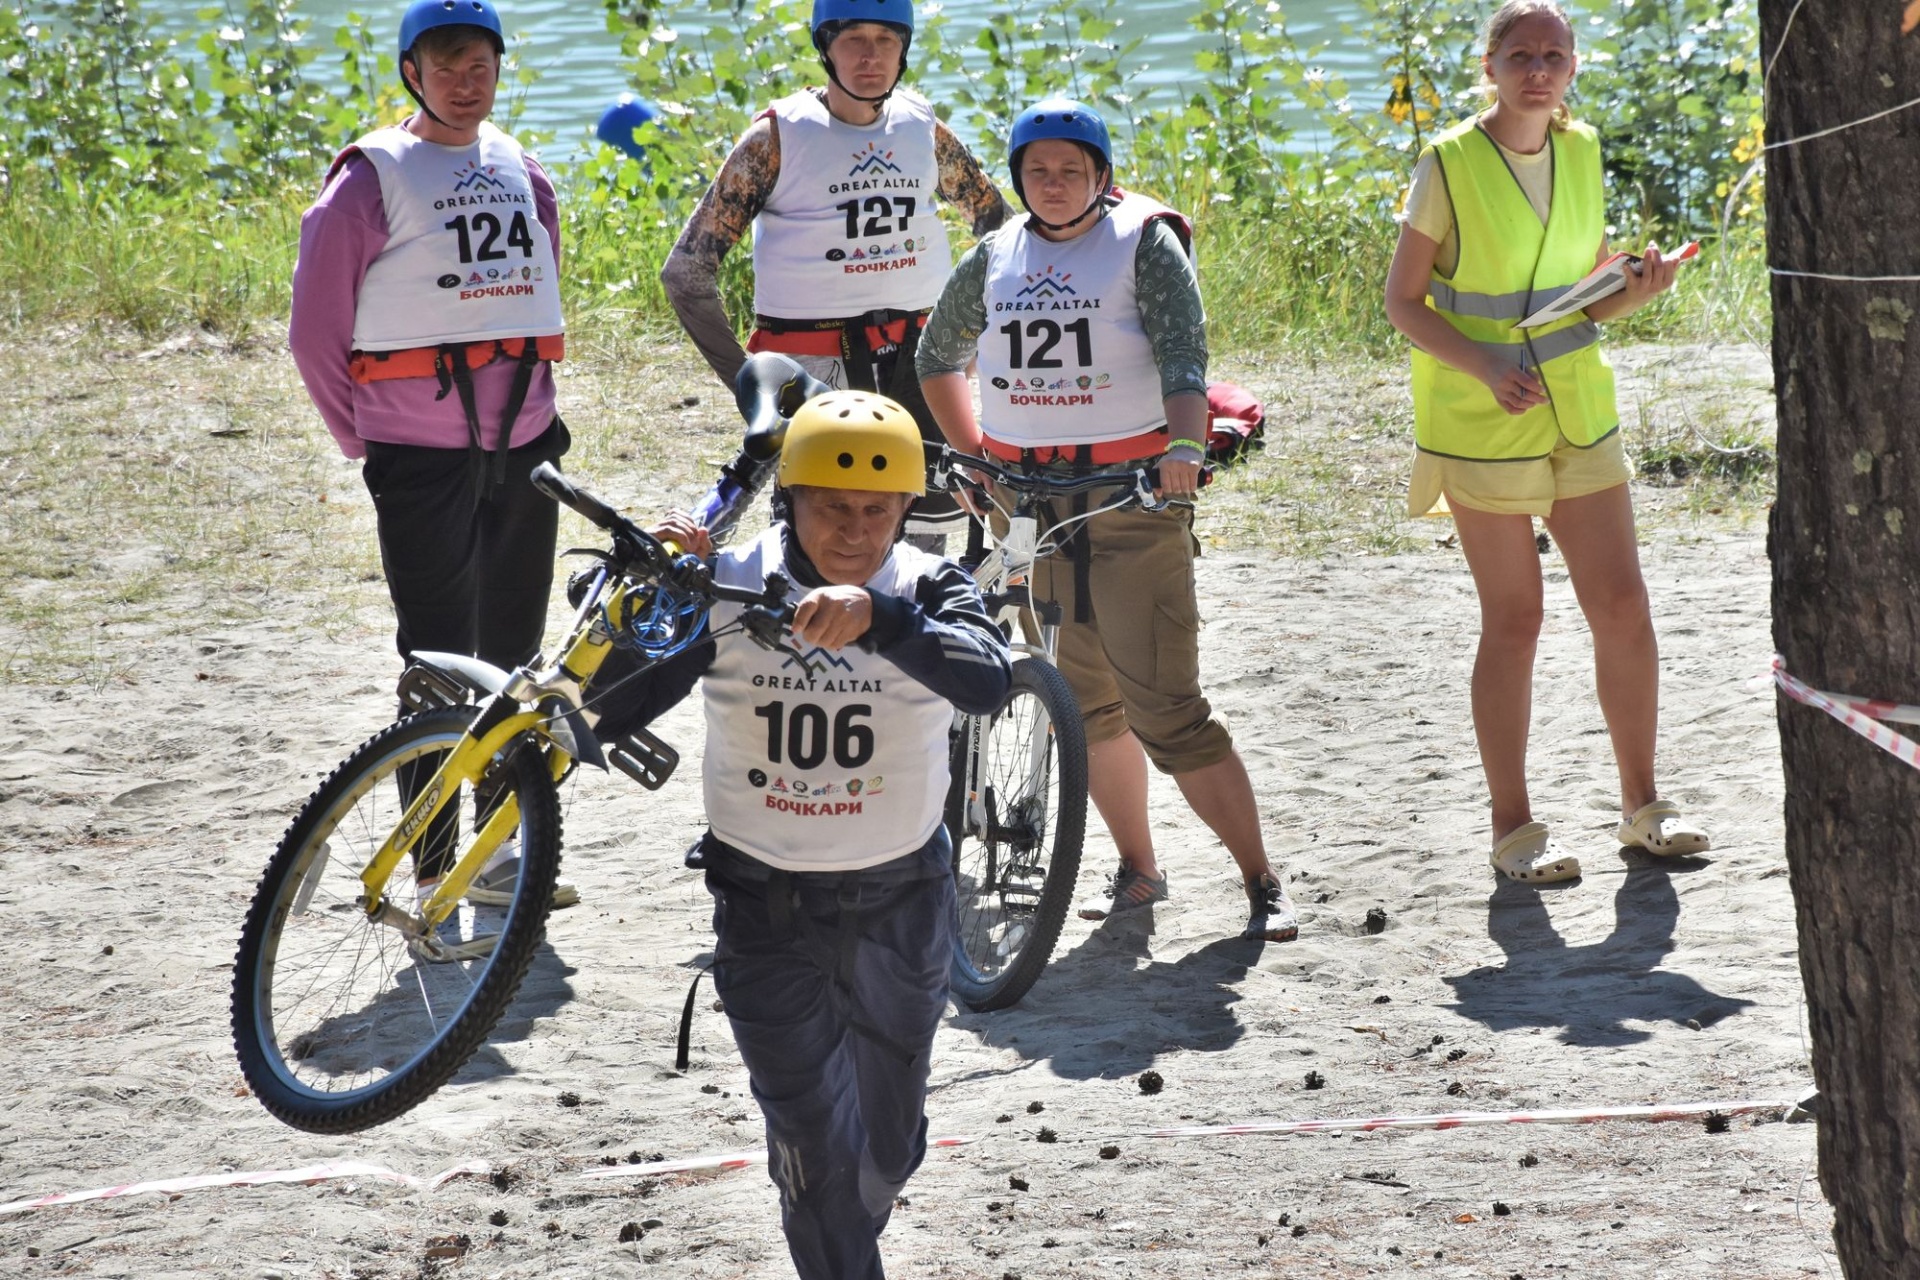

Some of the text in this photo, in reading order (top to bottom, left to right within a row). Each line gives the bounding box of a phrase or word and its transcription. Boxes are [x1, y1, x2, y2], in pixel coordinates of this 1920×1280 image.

[829, 178, 920, 194] GREAT ALTAI
[433, 193, 527, 210] GREAT ALTAI
[836, 196, 916, 239] 127
[445, 211, 534, 263] 124
[844, 257, 917, 274] БОЧКАРИ
[460, 285, 534, 300] БОЧКАРИ
[995, 299, 1100, 312] GREAT ALTAI
[1000, 318, 1092, 369] 121
[1010, 394, 1093, 406] БОЧКАРИ
[752, 674, 882, 693] GREAT ALTAI
[755, 700, 874, 770] 106
[765, 795, 863, 816] БОЧКАРИ
